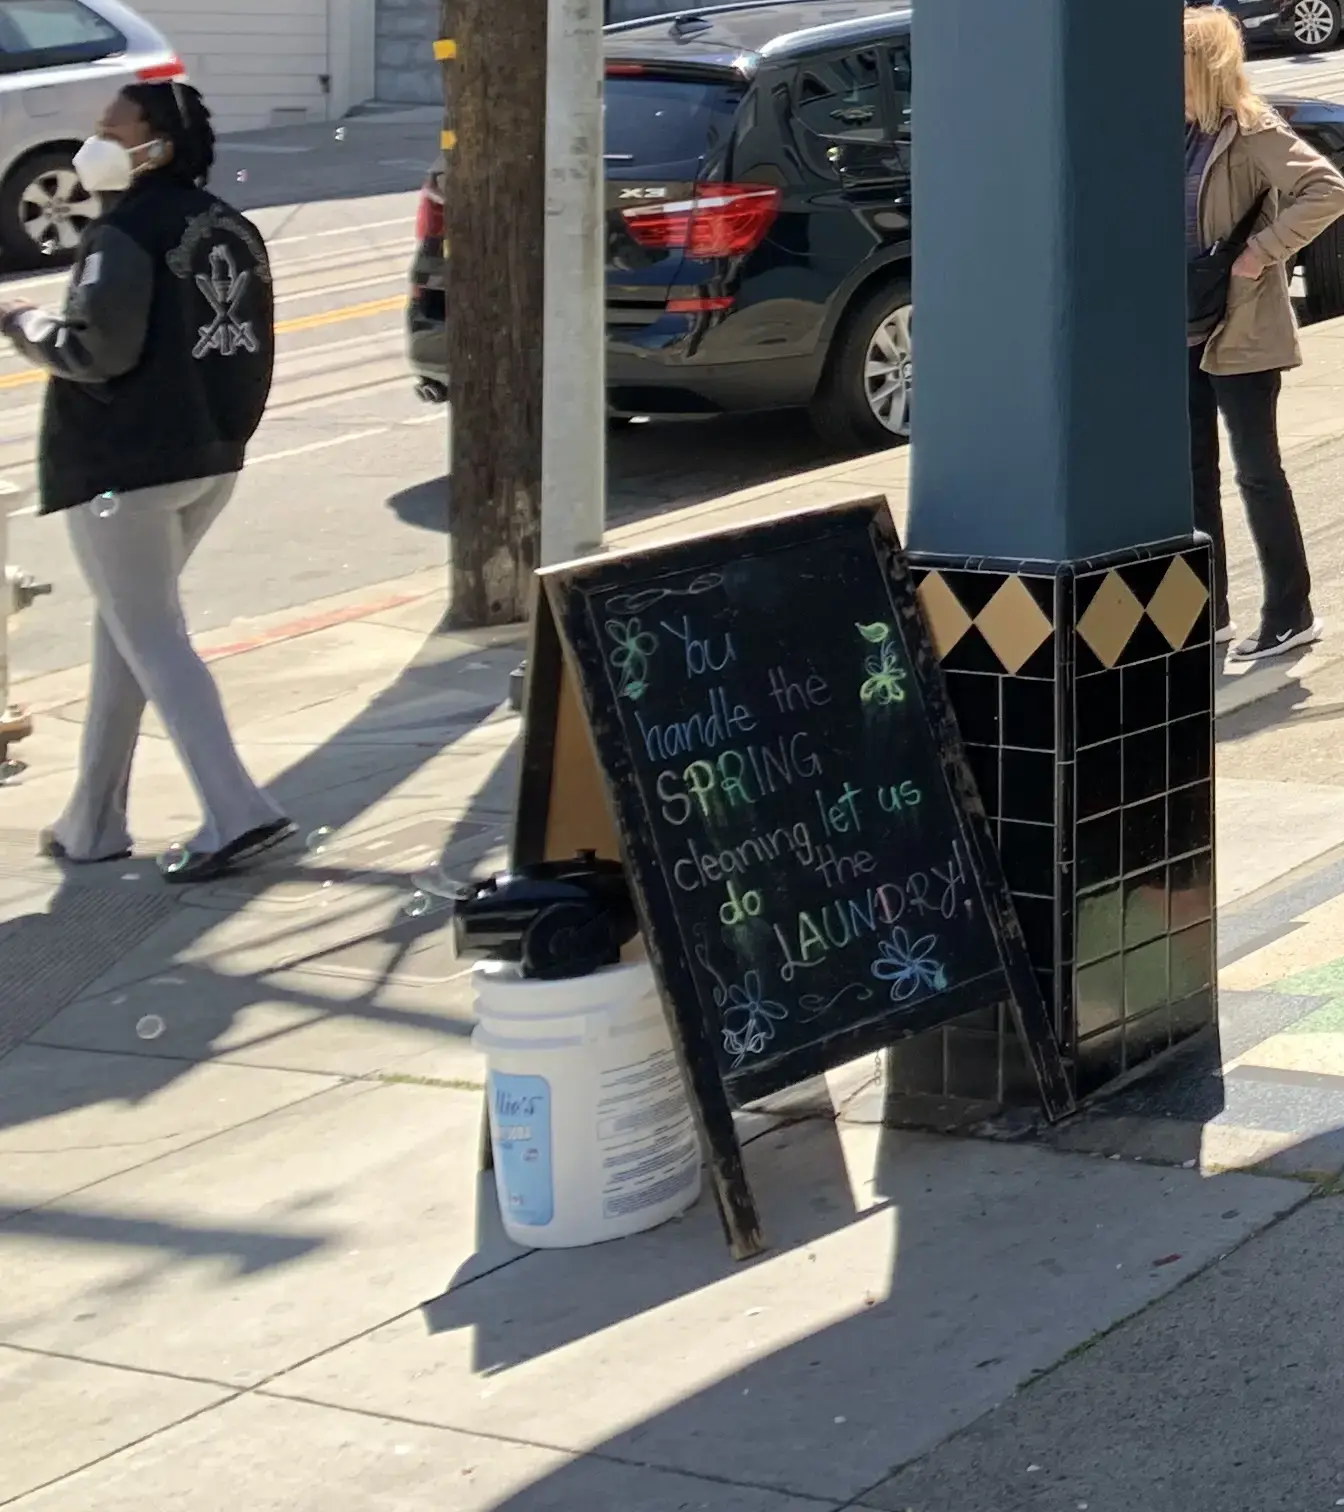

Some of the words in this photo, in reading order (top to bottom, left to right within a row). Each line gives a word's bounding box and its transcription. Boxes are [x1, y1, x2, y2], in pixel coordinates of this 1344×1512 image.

[618, 187, 665, 198] X3
[661, 614, 736, 680] You
[634, 687, 758, 763] handle
[767, 667, 833, 716] the
[655, 730, 823, 826] SPRING
[672, 819, 813, 894] cleaning
[816, 781, 863, 839] let
[879, 776, 922, 815] us
[718, 881, 762, 927] do
[816, 841, 878, 890] the
[772, 838, 973, 984] LAUNDRY!
